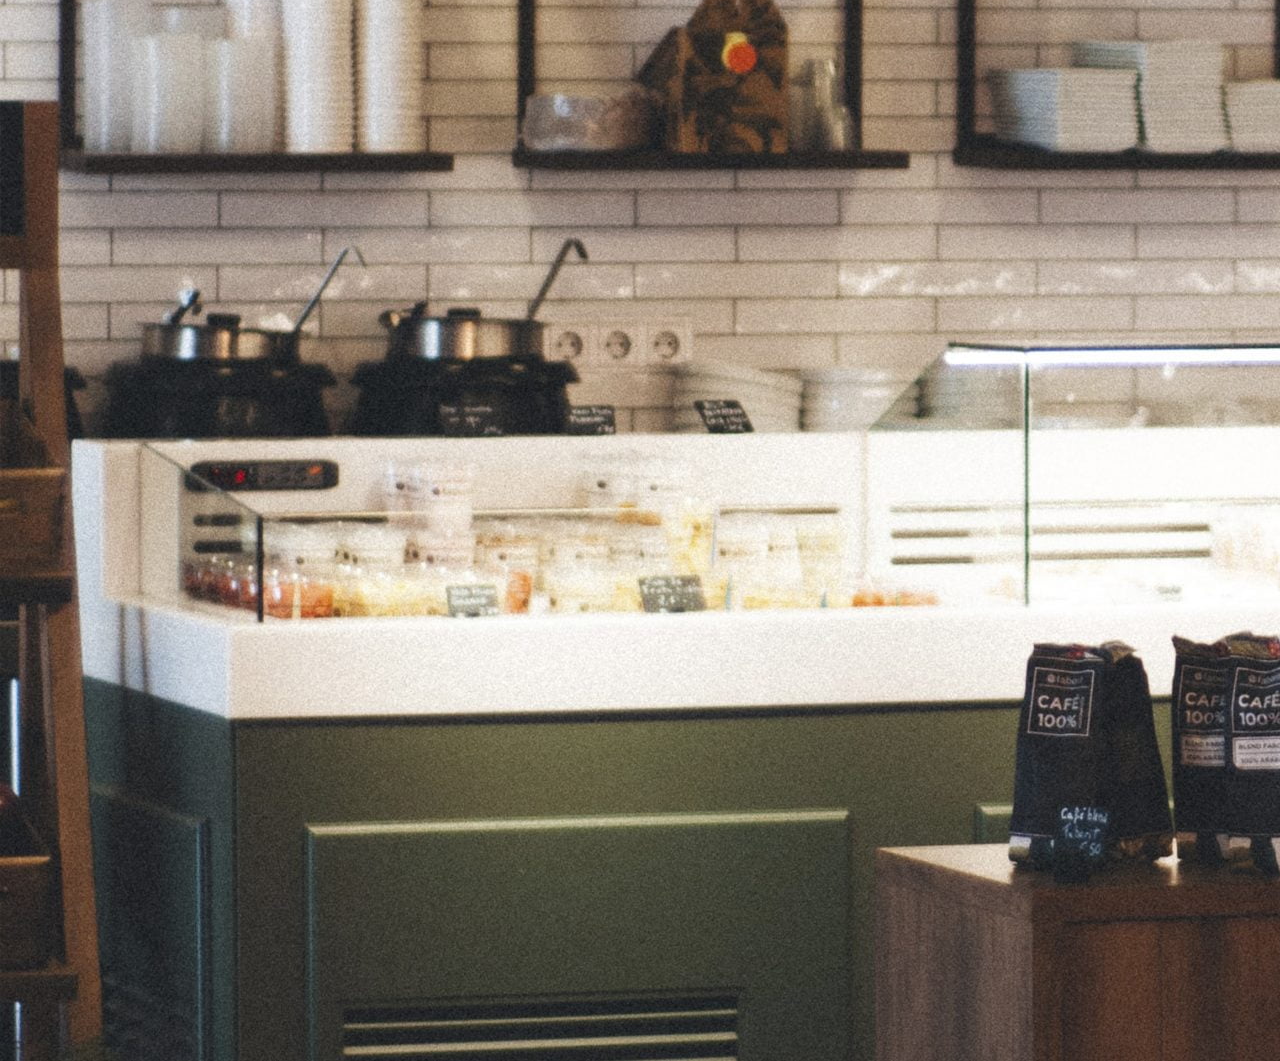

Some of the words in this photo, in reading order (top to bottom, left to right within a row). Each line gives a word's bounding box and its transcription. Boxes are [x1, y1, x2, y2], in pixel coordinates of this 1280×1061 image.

[1037, 693, 1080, 711] CAFÉ
[1037, 712, 1078, 729] 100%
[1185, 709, 1226, 726] 100%
